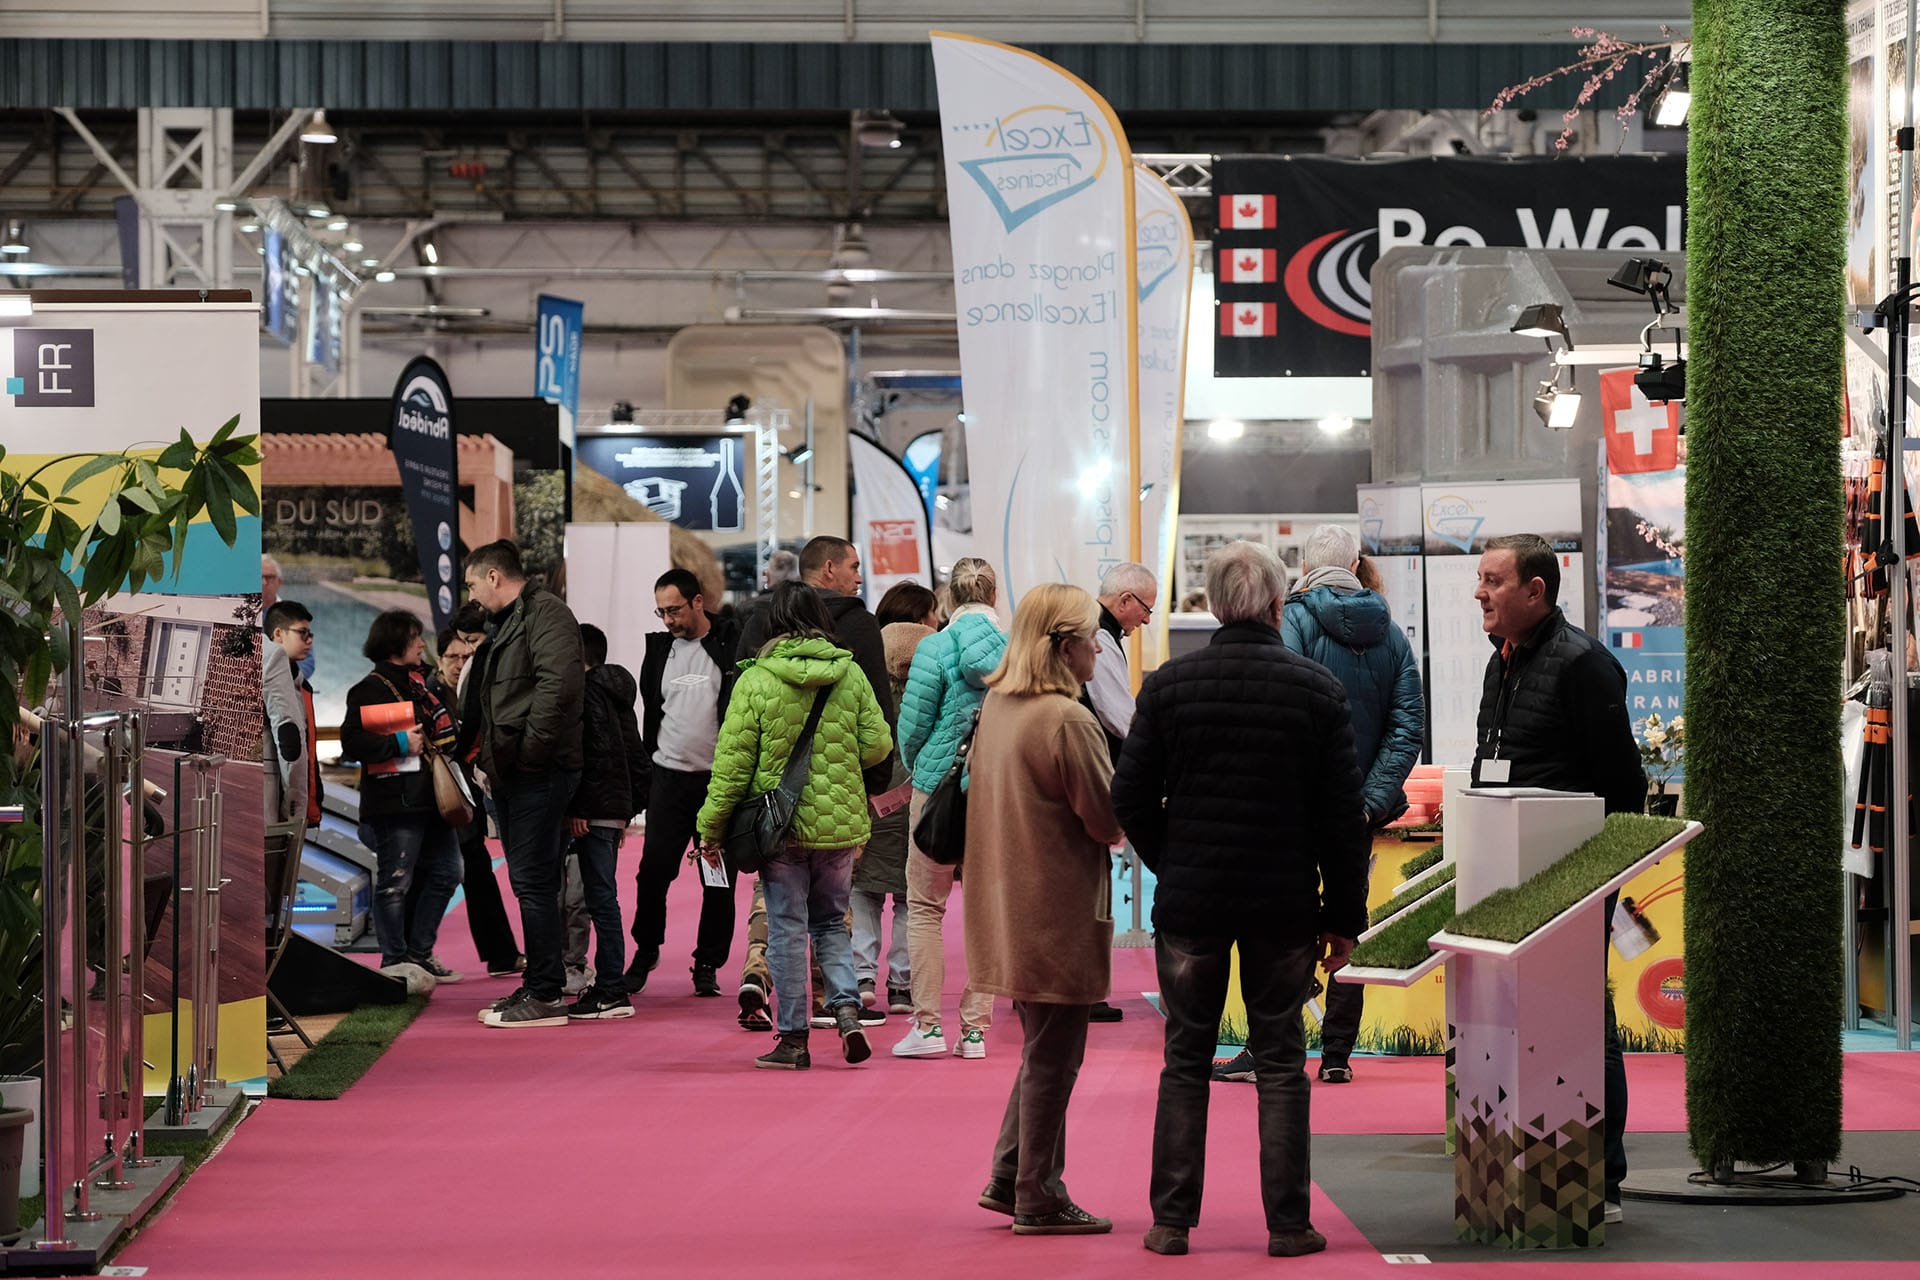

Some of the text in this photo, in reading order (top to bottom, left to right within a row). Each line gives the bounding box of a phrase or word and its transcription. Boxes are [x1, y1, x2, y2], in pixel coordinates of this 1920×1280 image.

[38, 343, 73, 394] FR
[539, 312, 565, 405] PS
[276, 498, 383, 525] DU SUD
